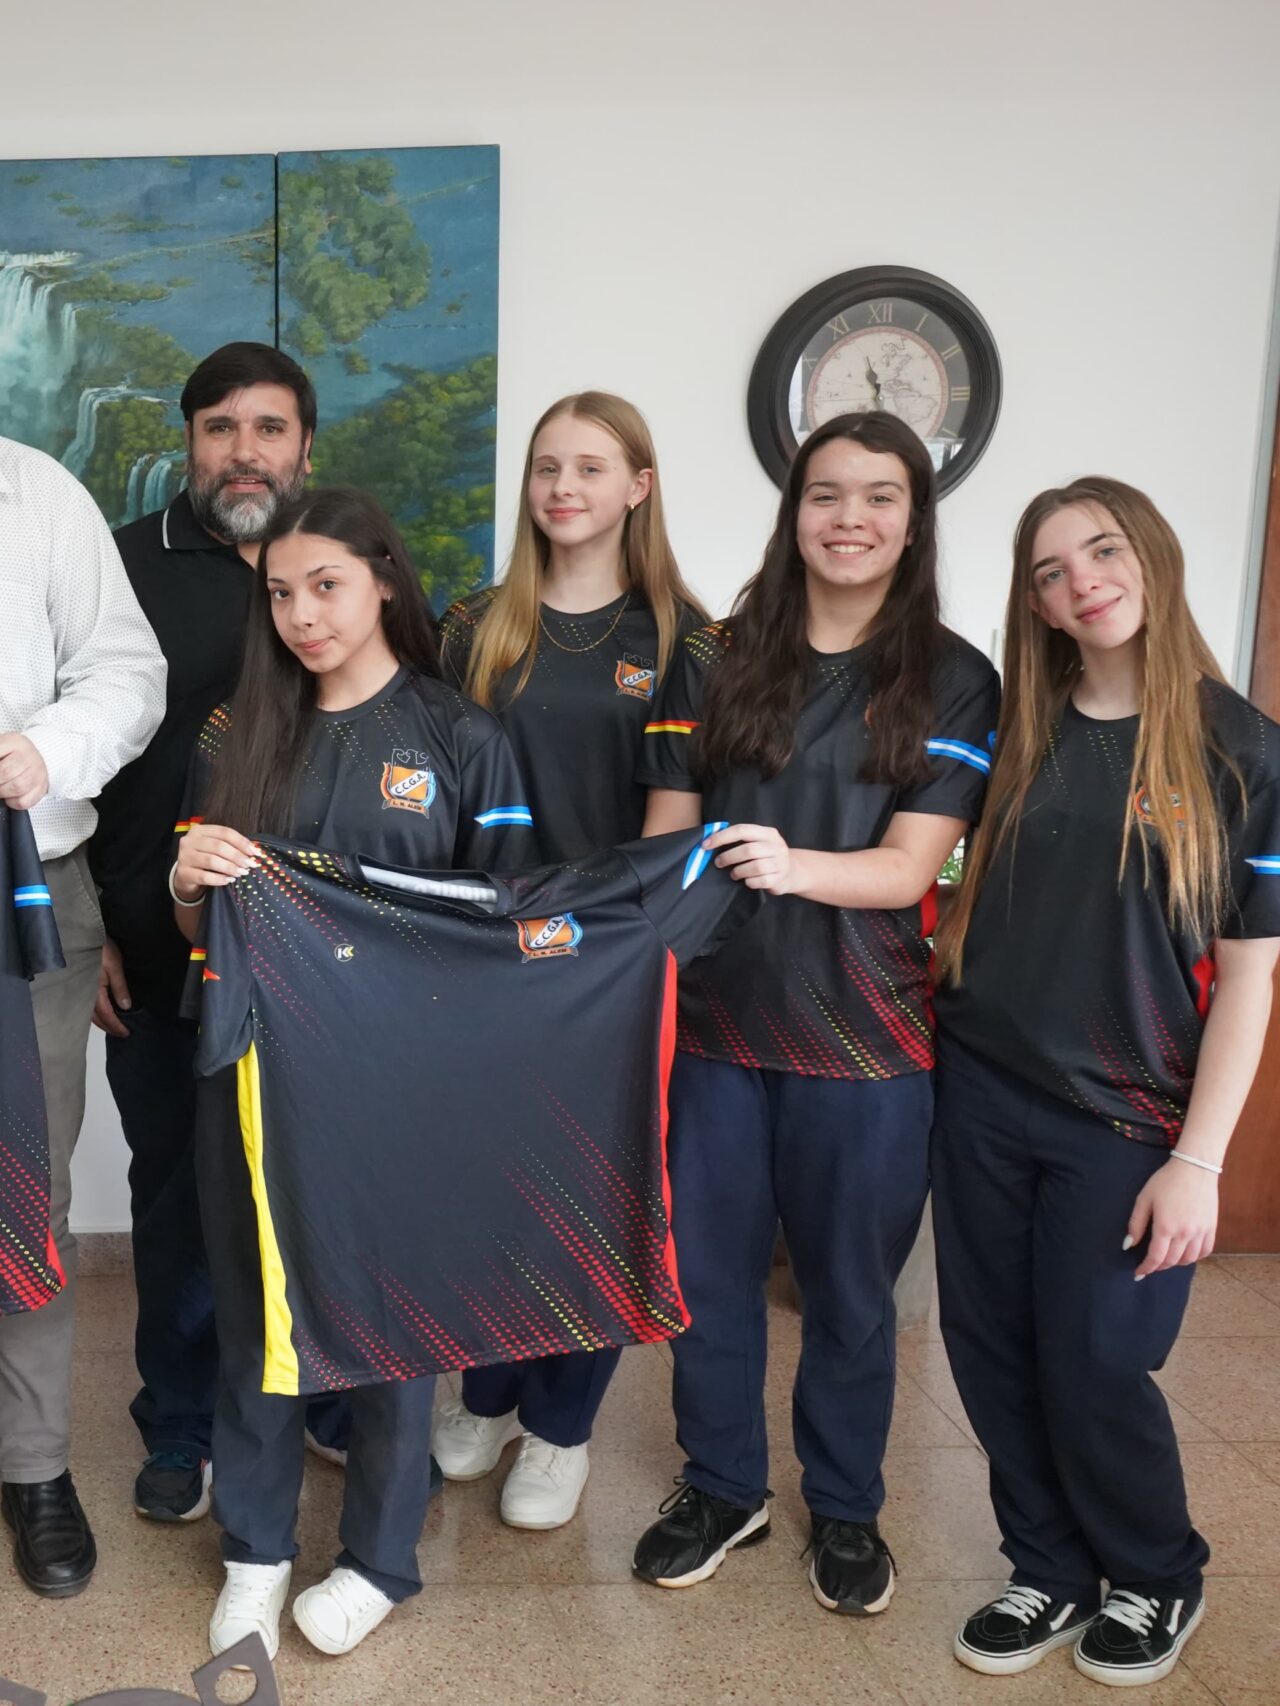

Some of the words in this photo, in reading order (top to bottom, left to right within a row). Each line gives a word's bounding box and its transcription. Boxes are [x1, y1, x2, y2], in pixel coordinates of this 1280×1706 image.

[868, 303, 893, 324] XII
[394, 773, 426, 795] C.C.G.A.
[534, 918, 563, 947] C.C.G.A.
